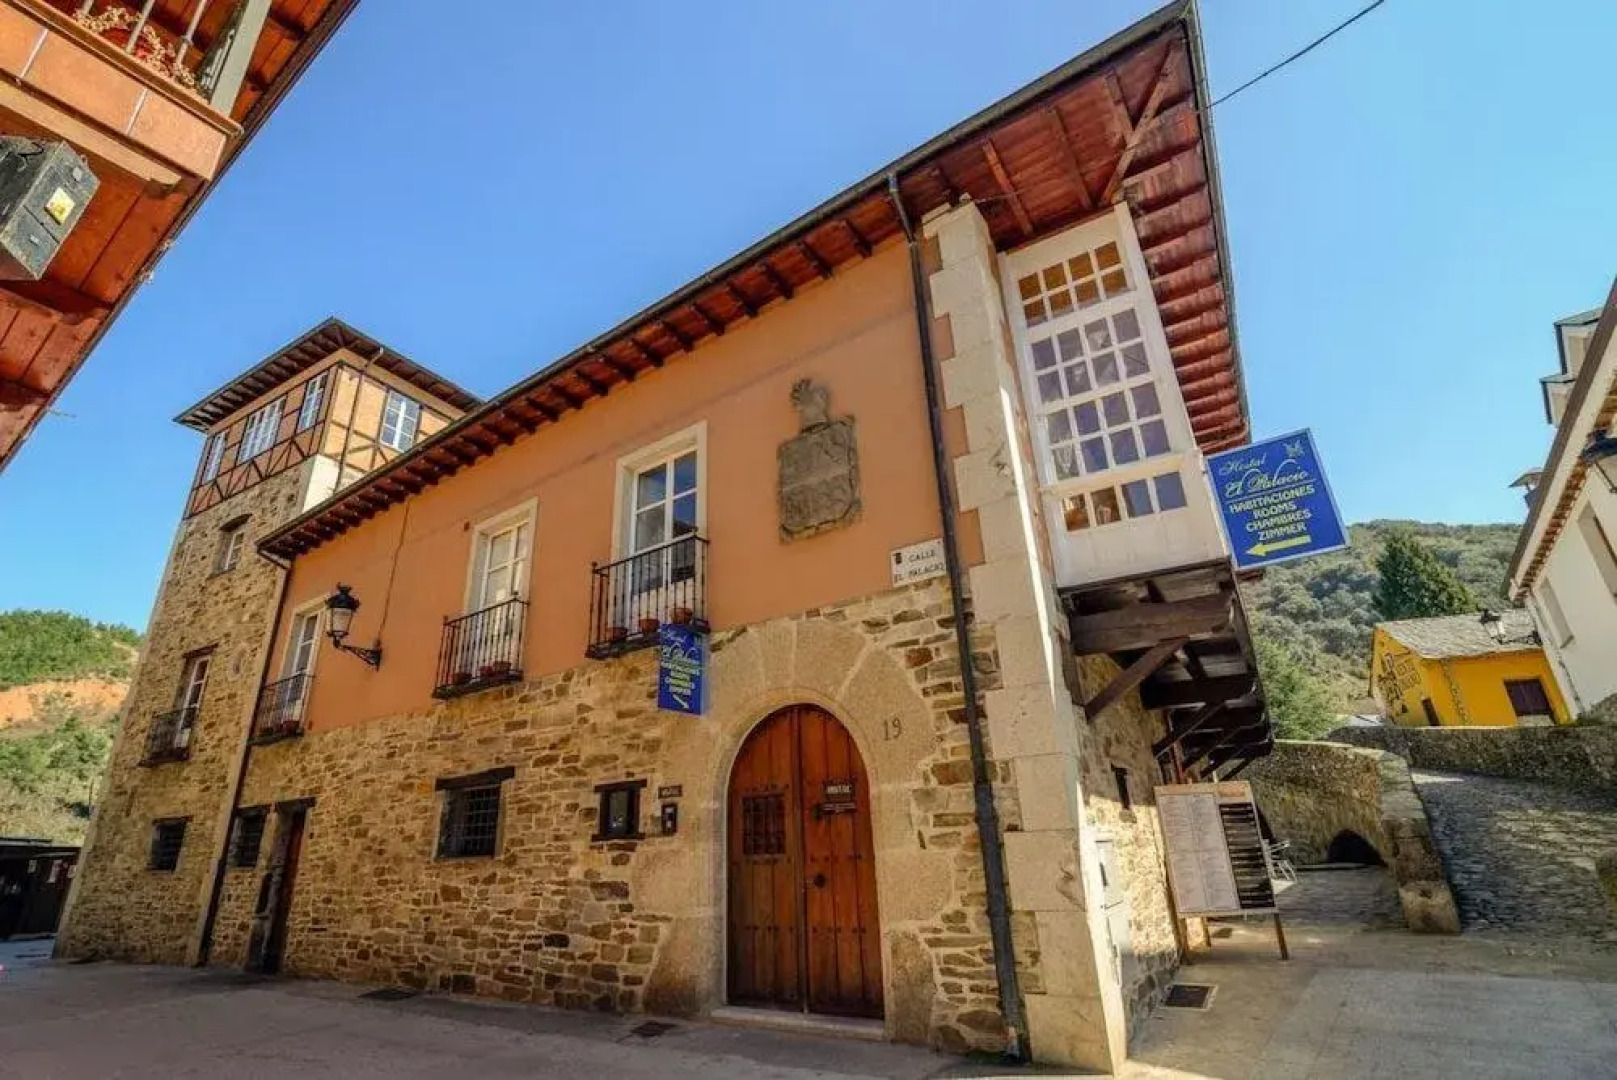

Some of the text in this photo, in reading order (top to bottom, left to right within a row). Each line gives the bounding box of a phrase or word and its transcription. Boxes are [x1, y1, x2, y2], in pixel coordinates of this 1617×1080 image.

[1247, 459, 1308, 493] Palacio
[1229, 484, 1315, 515] HABITACIONES
[1253, 501, 1297, 519] ROOMS
[1246, 508, 1313, 533] CHAMBRES
[1257, 522, 1307, 541] ZIMMER
[909, 549, 935, 562] CALLE
[883, 718, 902, 741] 19
